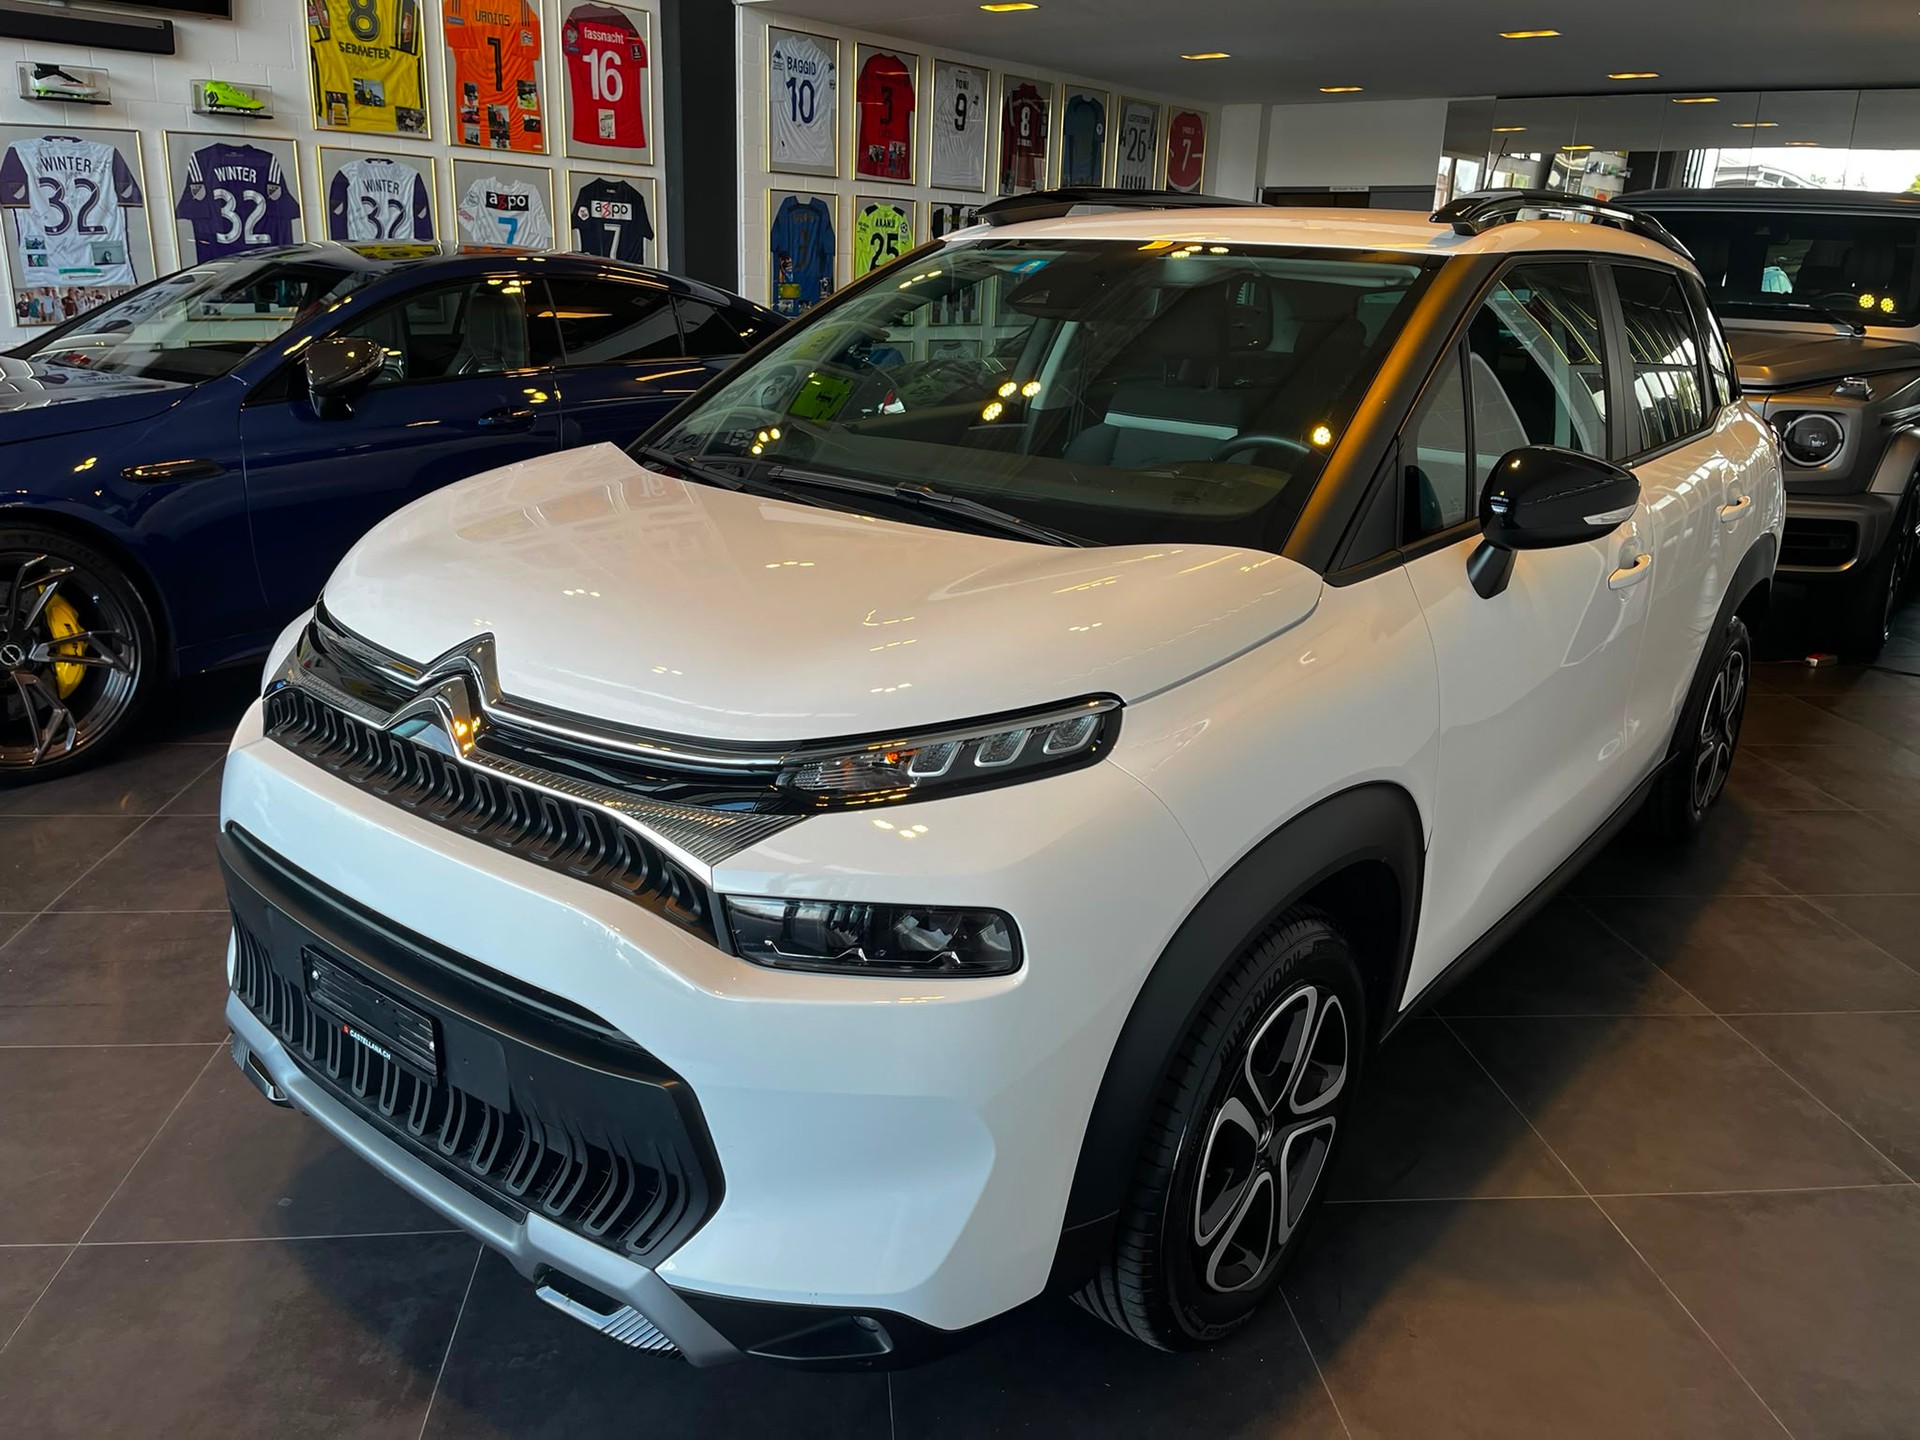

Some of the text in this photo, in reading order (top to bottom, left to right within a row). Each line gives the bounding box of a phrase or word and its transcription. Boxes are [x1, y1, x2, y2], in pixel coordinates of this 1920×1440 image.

[348, 0, 381, 42] 8
[486, 36, 504, 92] 1
[582, 48, 624, 102] 16
[786, 76, 815, 124] 10
[954, 92, 967, 132] 9
[1020, 105, 1031, 137] 8
[1127, 127, 1146, 163] 26
[1182, 138, 1192, 172] 7
[40, 156, 93, 174] WINTER
[214, 166, 257, 184] WINTER
[362, 180, 400, 195] WINTER
[38, 177, 109, 237] 32
[213, 188, 272, 245] 32
[498, 217, 519, 246] 7
[604, 223, 622, 260] 7
[869, 232, 900, 271] 25
